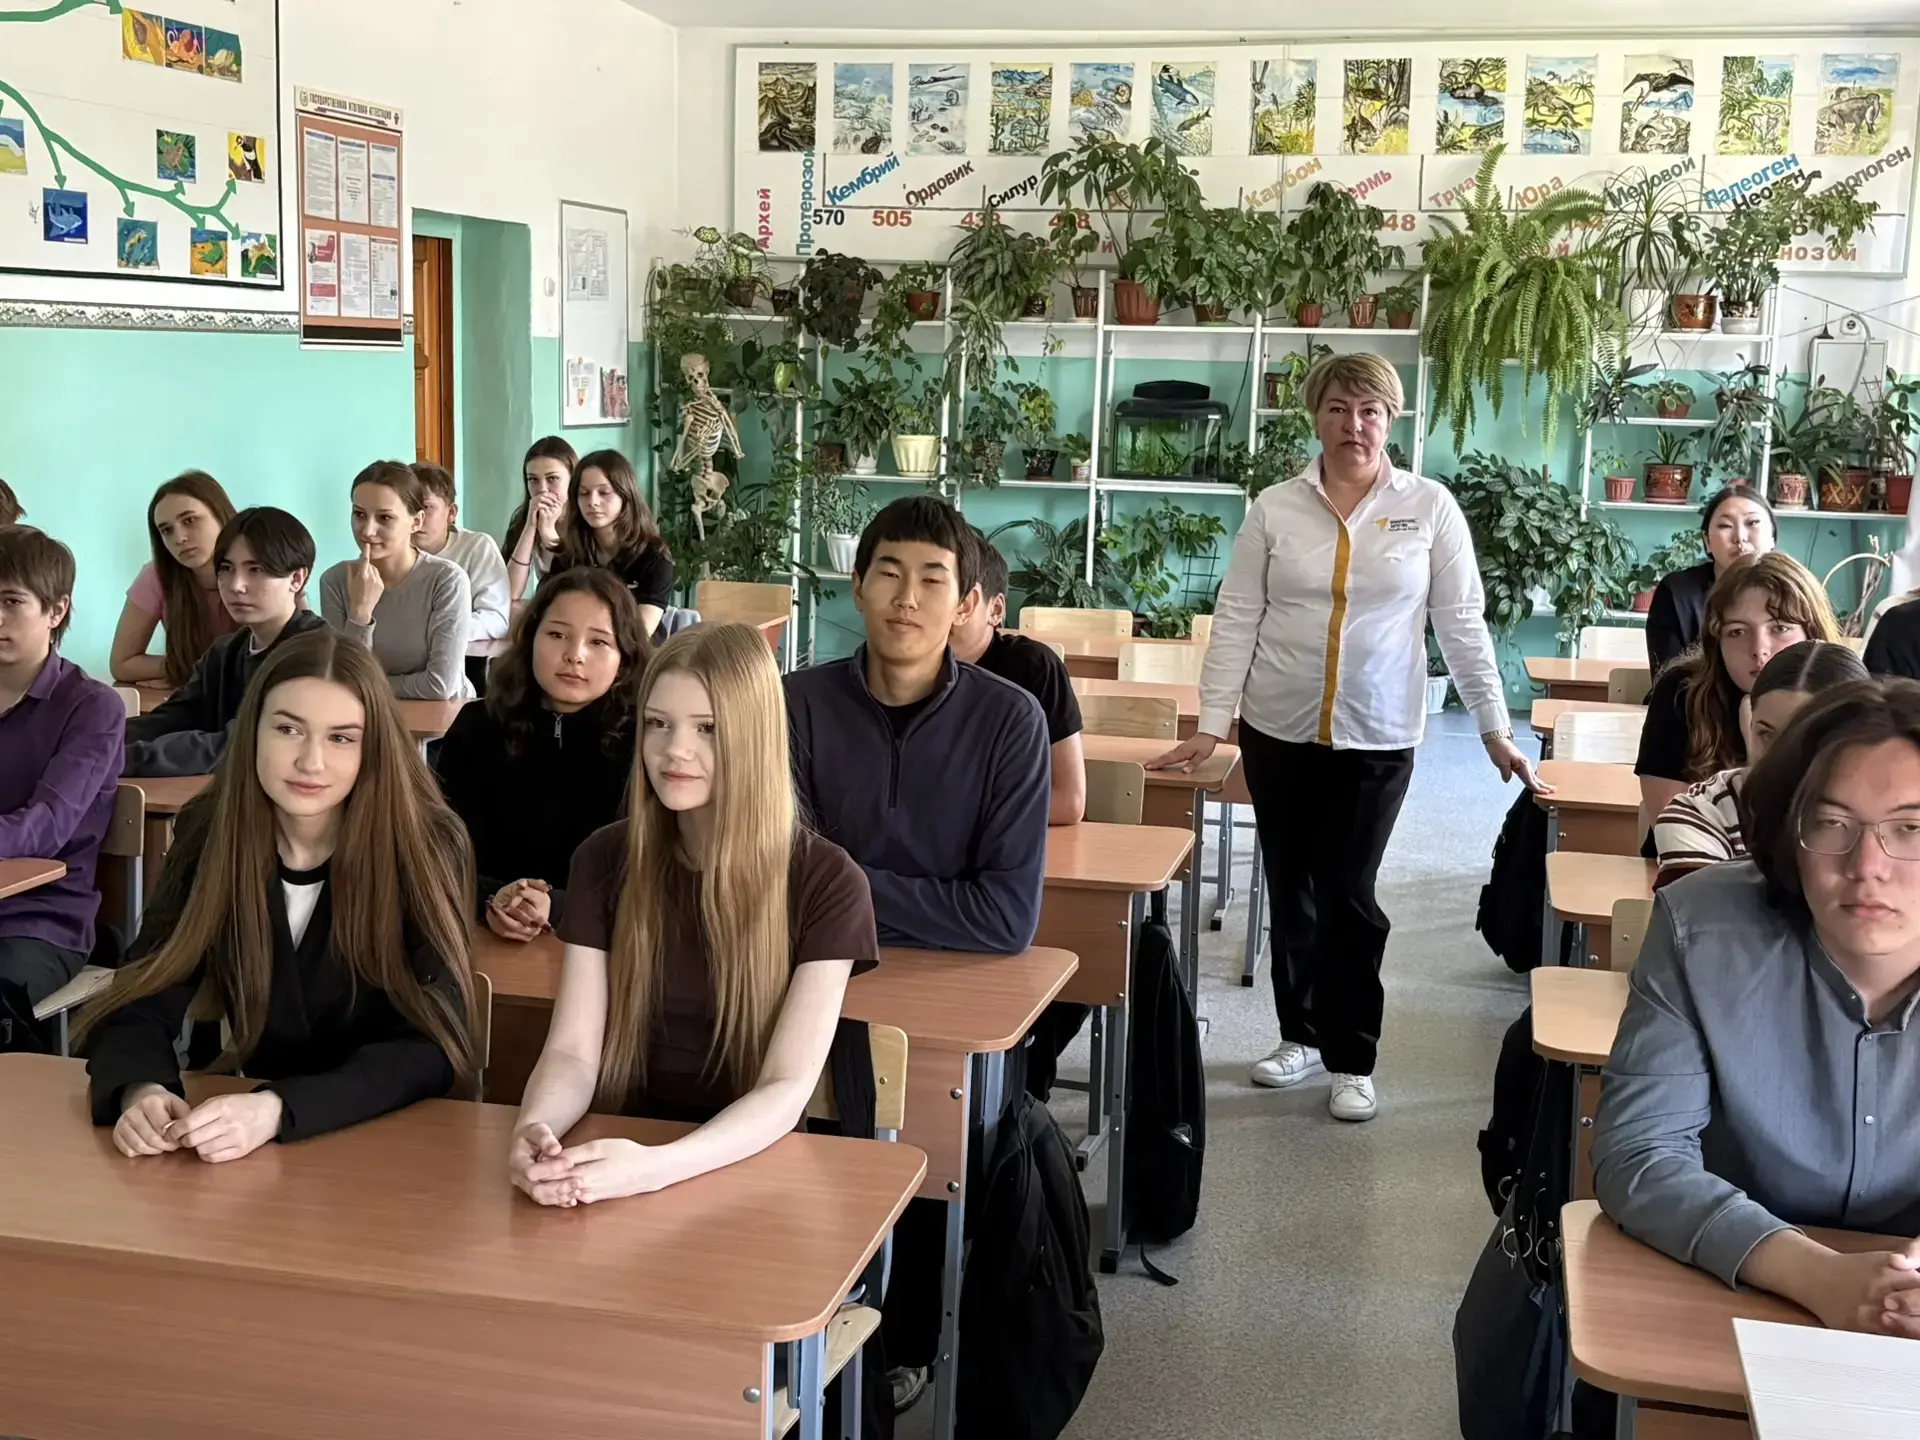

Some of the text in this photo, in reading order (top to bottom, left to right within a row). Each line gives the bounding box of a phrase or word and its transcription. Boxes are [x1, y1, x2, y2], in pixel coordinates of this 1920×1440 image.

[826, 151, 900, 206] Кембрий
[905, 160, 974, 206] Ордовик
[988, 175, 1038, 208] Силур
[1245, 157, 1323, 209] Карбон
[1336, 170, 1392, 200] ермь
[1429, 176, 1478, 208] Триа
[1515, 175, 1564, 208] Юра
[1704, 153, 1800, 209] Палеоген
[1732, 168, 1806, 211] Неон
[757, 188, 773, 249] Архей
[812, 209, 845, 225] 570
[872, 210, 912, 227] 505
[1048, 212, 1090, 229] 48
[1383, 213, 1416, 231] 48
[1780, 244, 1857, 261] нозой
